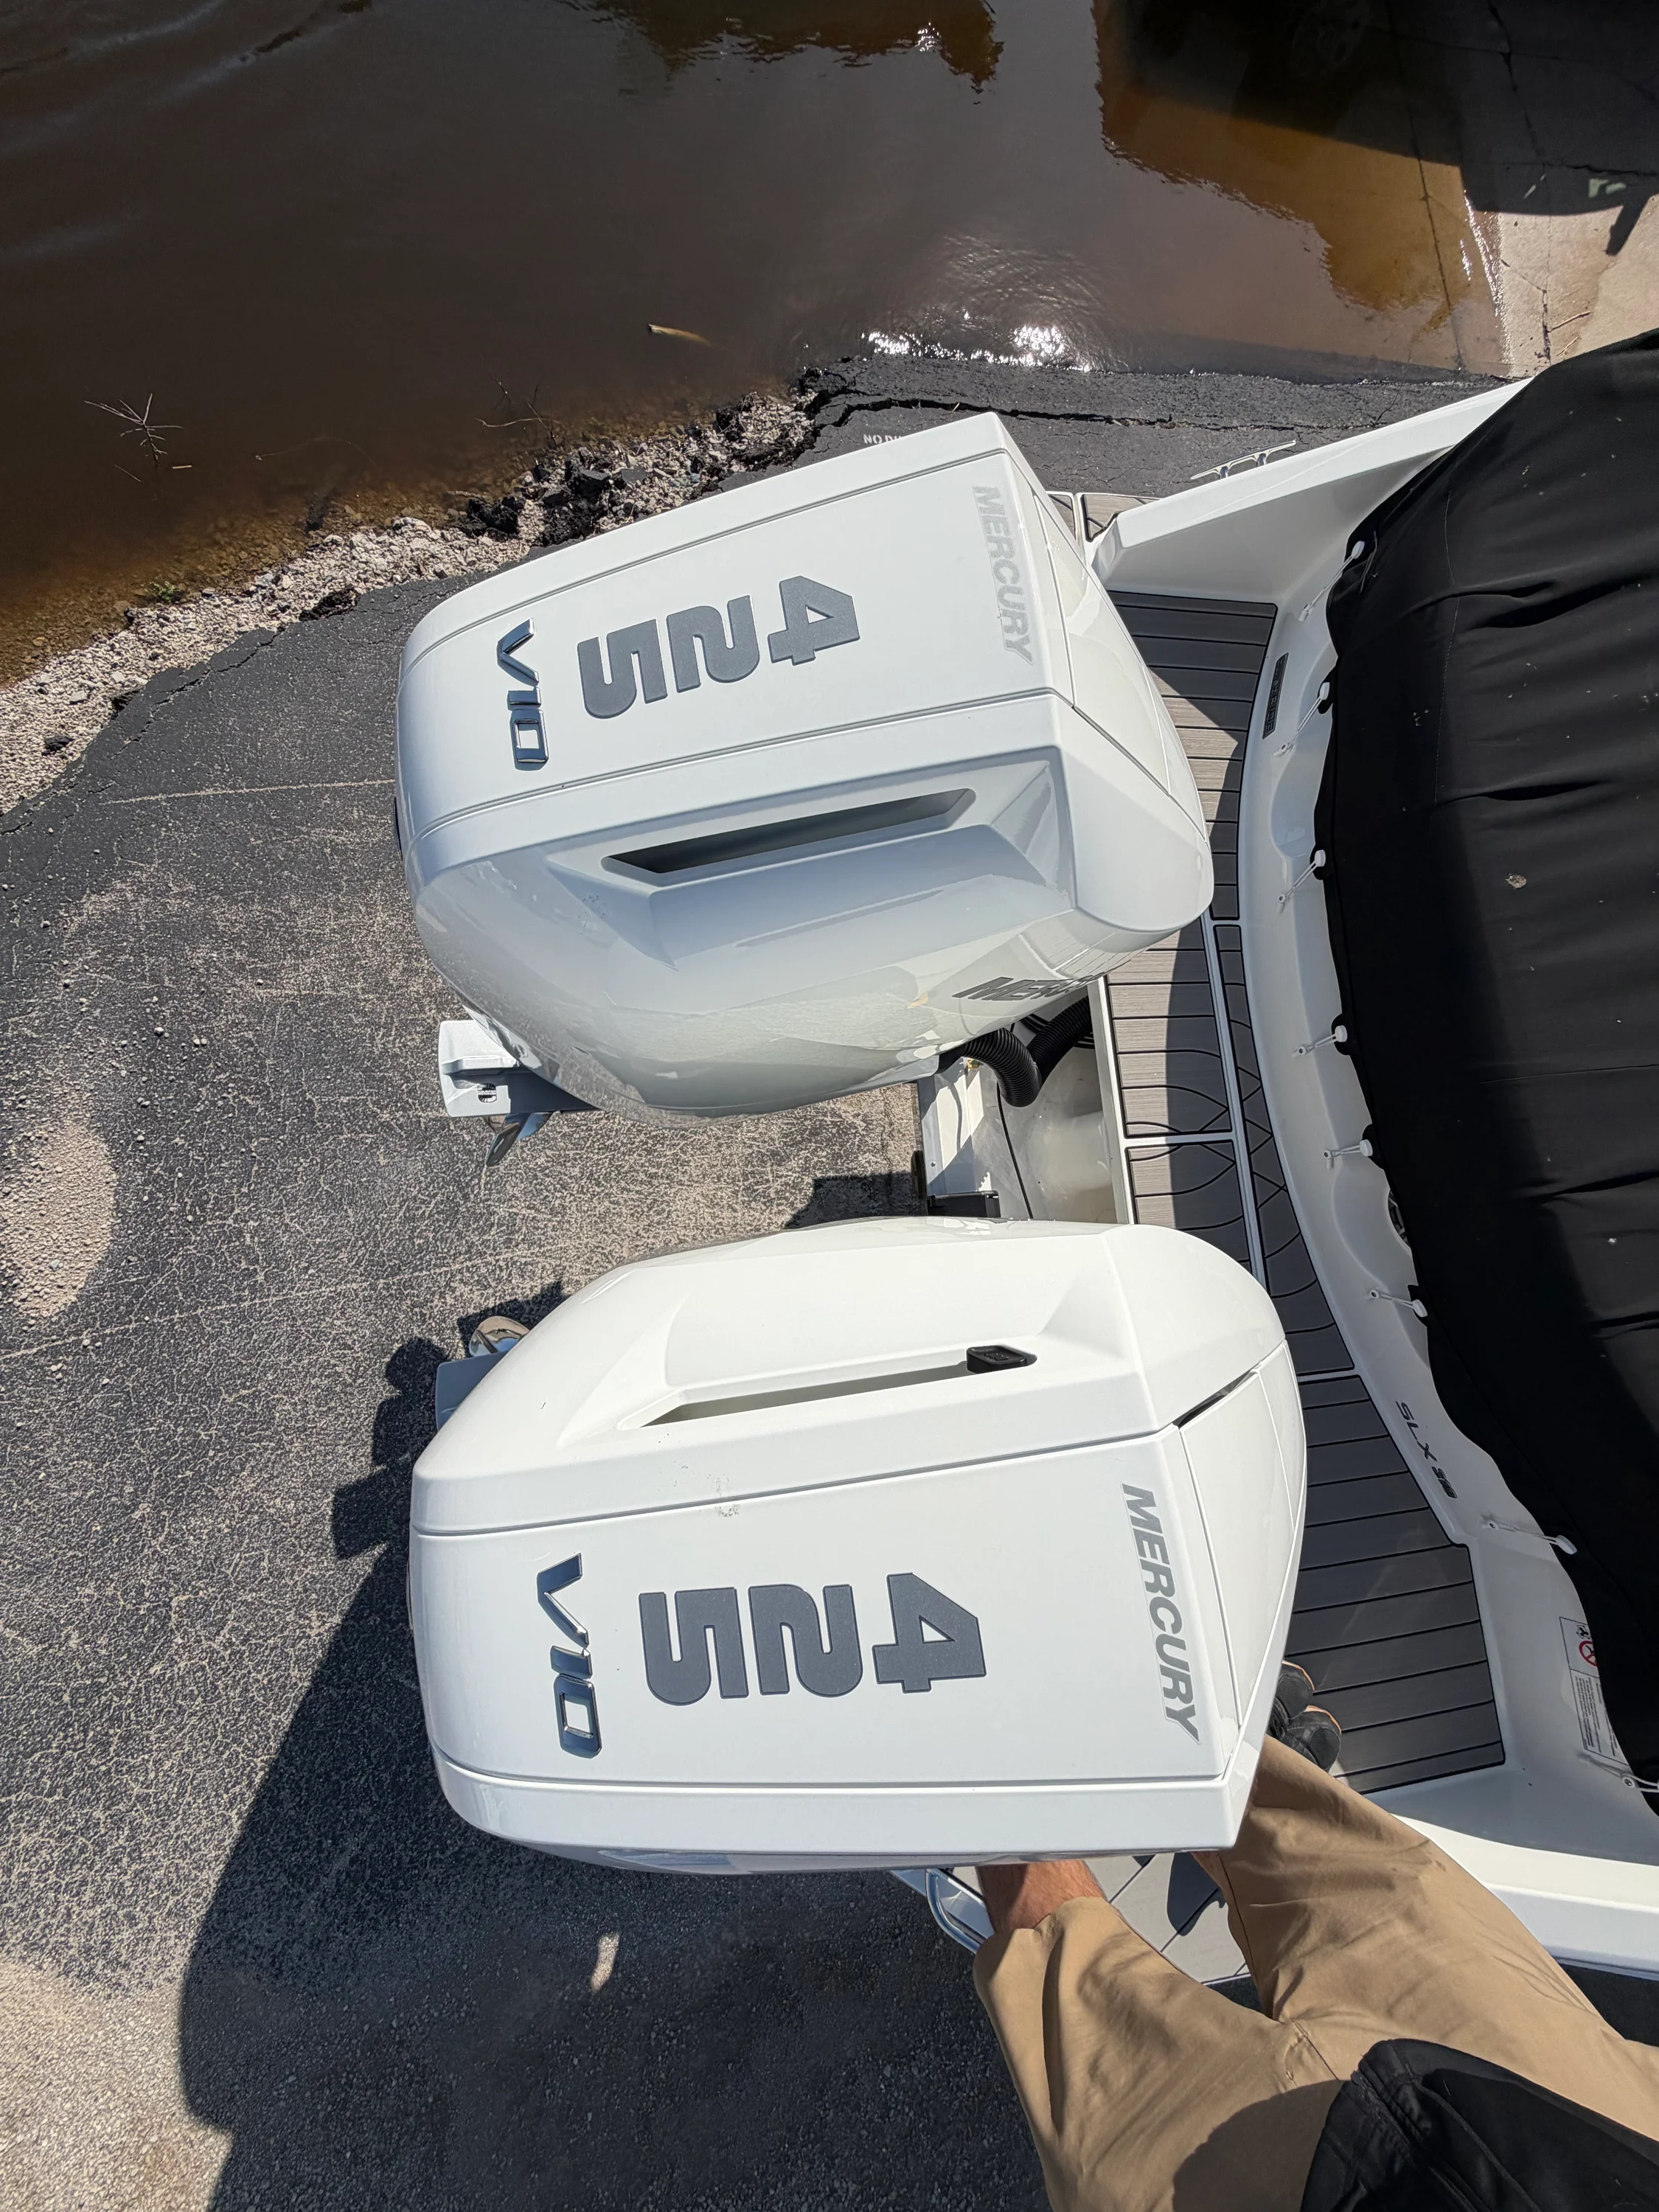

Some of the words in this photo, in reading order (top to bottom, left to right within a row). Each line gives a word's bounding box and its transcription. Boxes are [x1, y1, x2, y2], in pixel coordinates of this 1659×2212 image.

[863, 434, 883, 444] NO
[971, 485, 1034, 663] MERCURY
[497, 617, 549, 765] V10
[577, 575, 860, 720] 425
[1396, 1400, 1438, 1462] SLX
[536, 1552, 602, 1759] V10
[639, 1571, 987, 1706] 425
[1121, 1483, 1200, 1743] MERCURY
